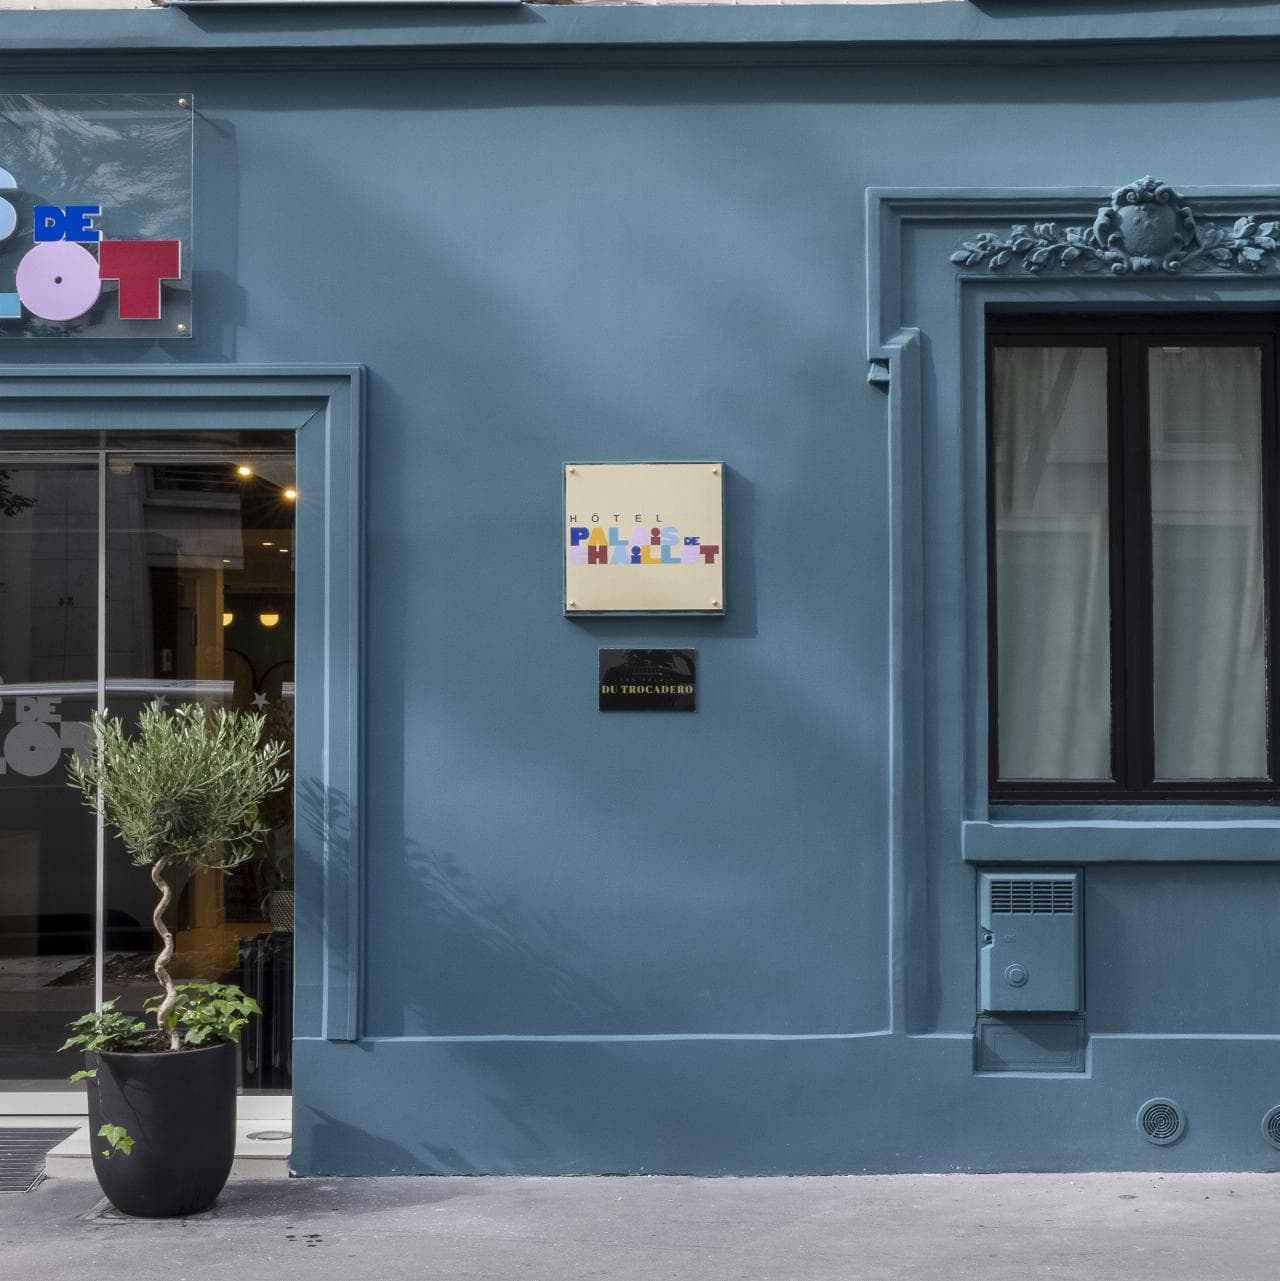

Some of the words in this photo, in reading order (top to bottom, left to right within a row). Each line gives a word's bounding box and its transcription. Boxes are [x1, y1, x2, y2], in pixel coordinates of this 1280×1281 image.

[33, 205, 102, 242] DE
[569, 513, 662, 522] HÔTEL
[684, 536, 701, 546] DE
[601, 685, 618, 694] DU
[620, 684, 694, 694] TROCADERO
[15, 695, 63, 722] DE
